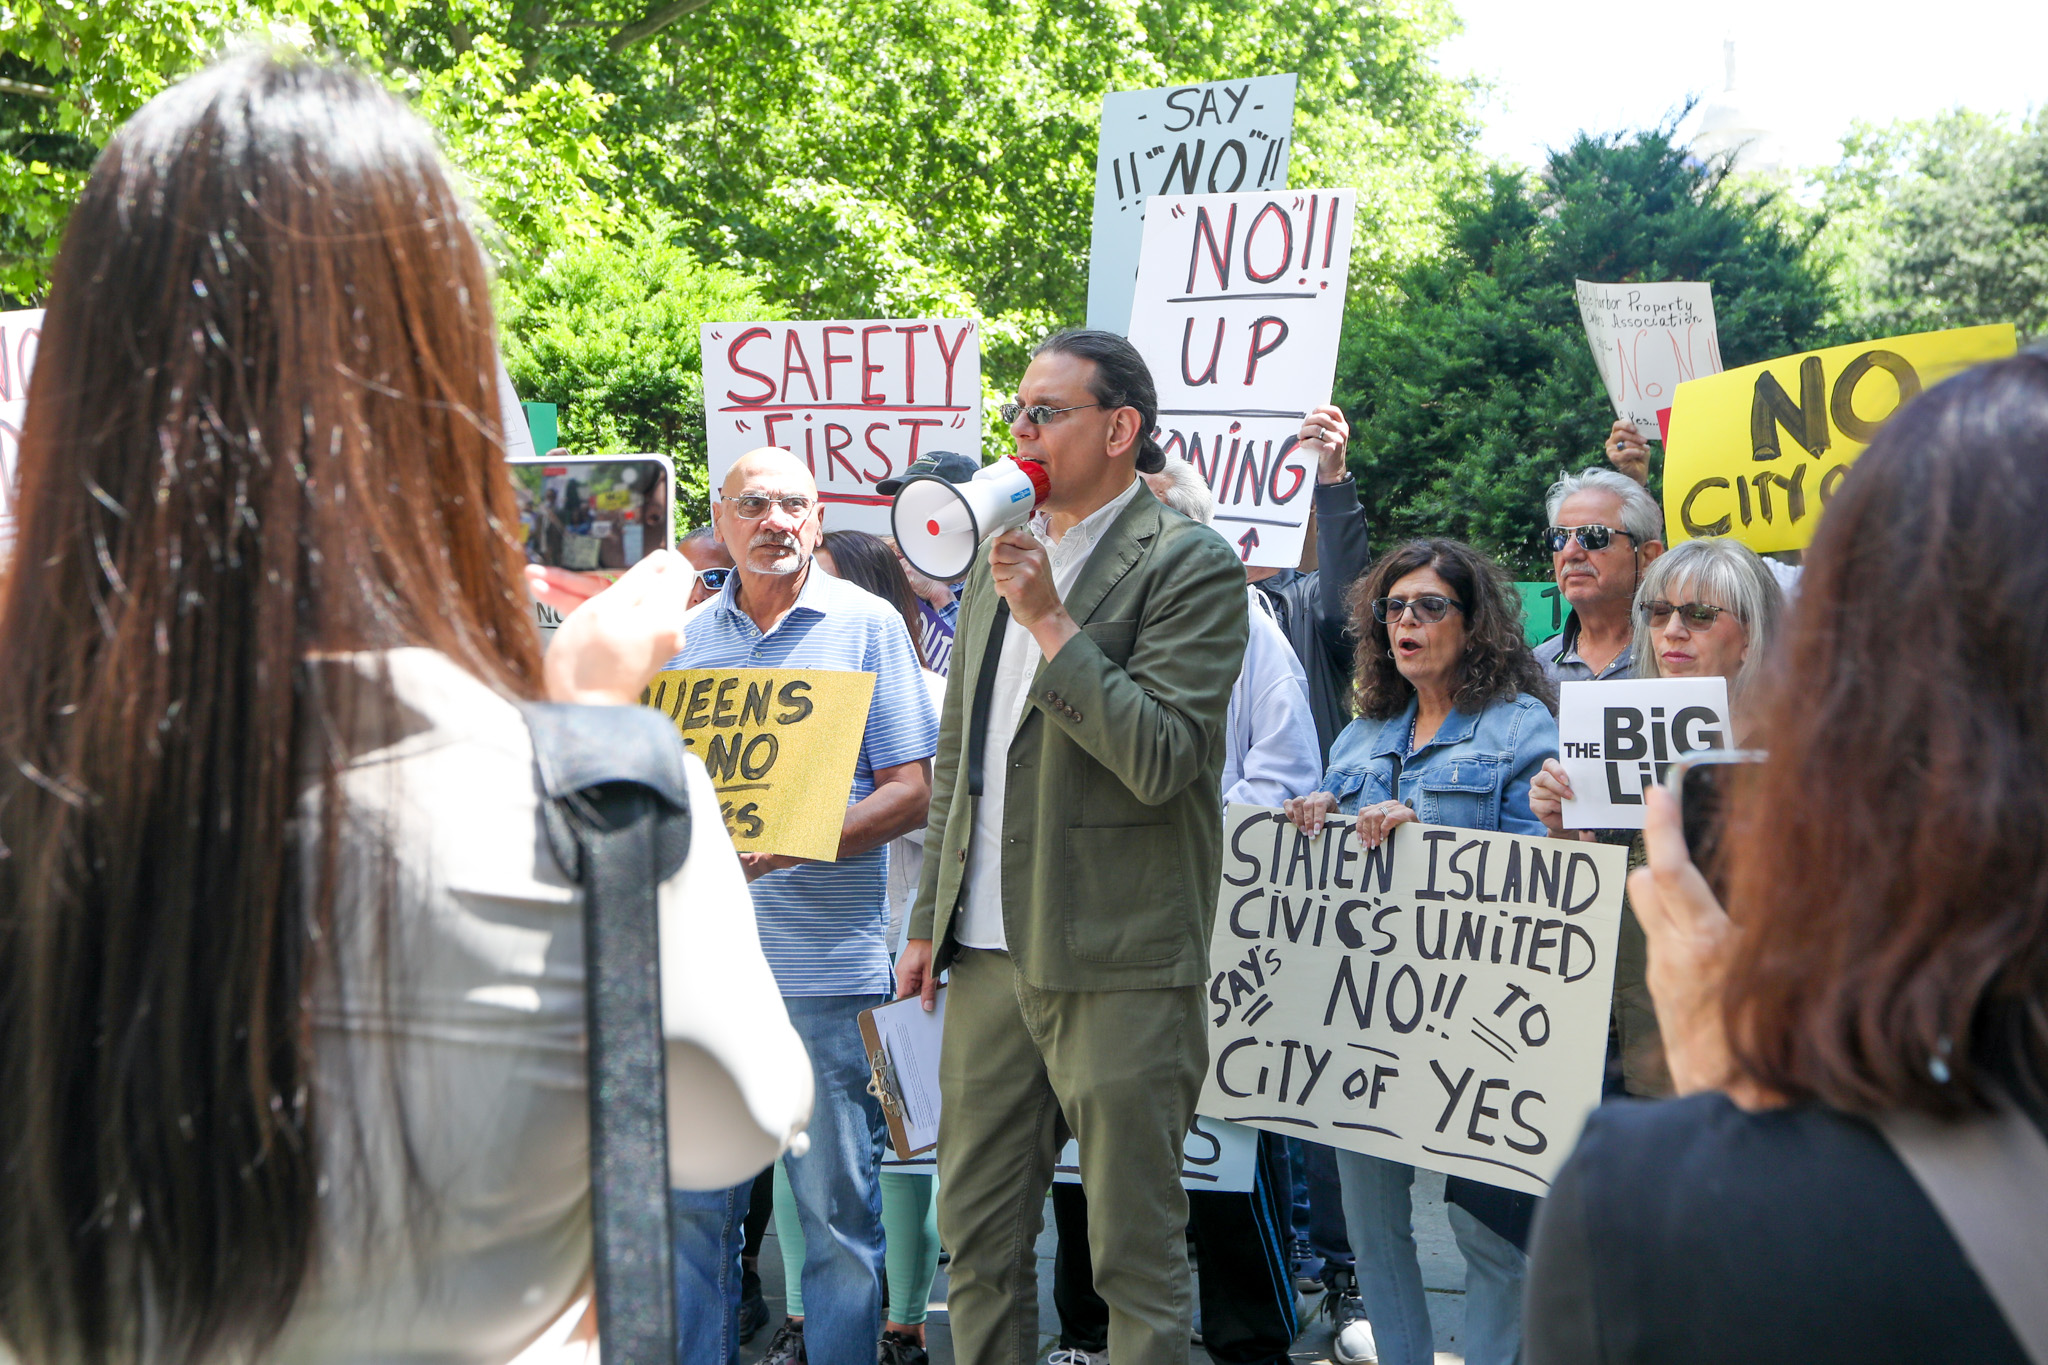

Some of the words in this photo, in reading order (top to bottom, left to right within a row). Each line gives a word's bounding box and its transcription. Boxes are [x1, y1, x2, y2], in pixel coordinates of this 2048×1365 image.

[1611, 312, 1703, 329] Association
[1628, 290, 1693, 319] Property
[1181, 315, 1289, 386] UP
[1751, 350, 1923, 462] NO
[1680, 463, 1807, 538] CITY
[640, 677, 813, 731] UEENS
[705, 732, 779, 783] NO
[1564, 742, 1600, 759] THE
[1223, 811, 1396, 894] STATEN
[1415, 830, 1600, 916] ISLAND
[1323, 956, 1468, 1040] NO!!
[1493, 983, 1551, 1047] TO
[1342, 1064, 1400, 1110] OF
[1429, 1059, 1548, 1156] YES
